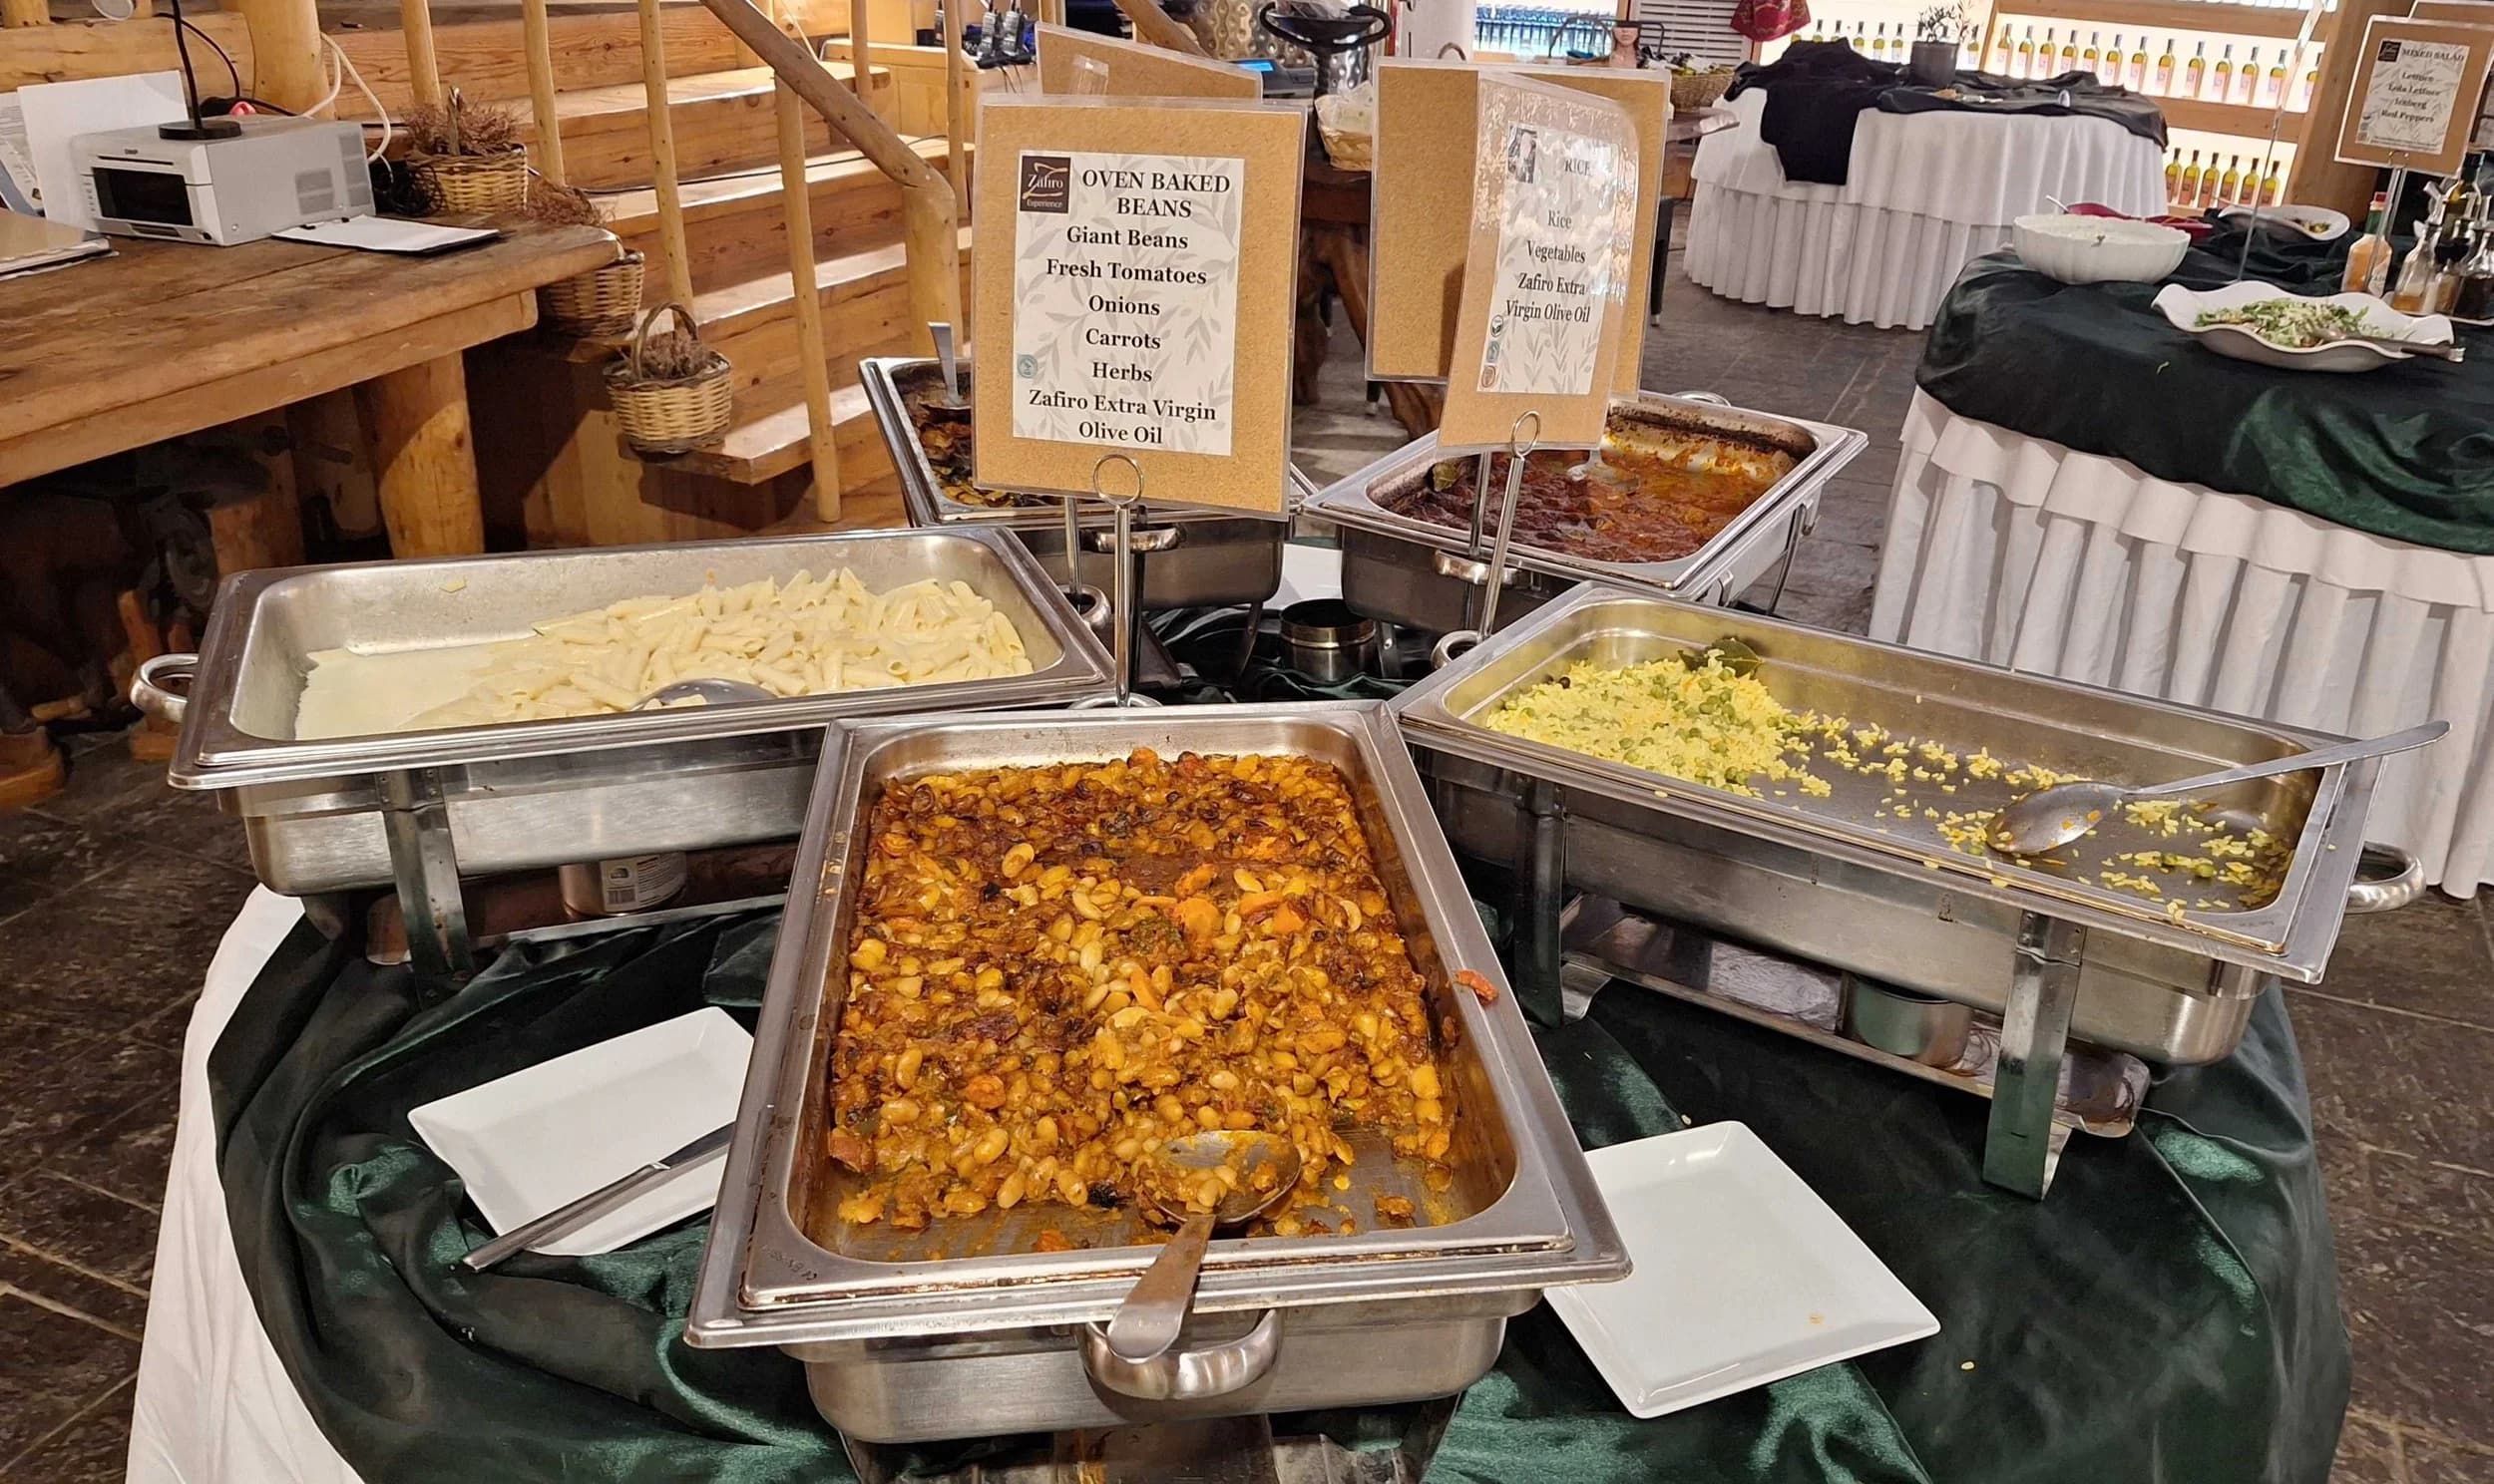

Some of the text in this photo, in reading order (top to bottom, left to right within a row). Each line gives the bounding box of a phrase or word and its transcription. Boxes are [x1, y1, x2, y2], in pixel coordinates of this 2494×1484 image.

[2402, 48, 2433, 58] MIXED
[2434, 51, 2465, 62] SALAD
[2394, 98, 2428, 110] Iceberg
[2399, 113, 2434, 123] Peppers
[1028, 174, 1063, 188] Zafiro
[1082, 170, 1230, 193] OVEN BAKED
[1027, 198, 1063, 208] Experience
[1116, 197, 1192, 218] BEANS
[1547, 209, 1572, 229] Rice
[1066, 226, 1189, 249] Giant Beans
[1526, 240, 1586, 264] Vegetables
[1046, 258, 1207, 284] Fresh Tomatoes
[1517, 272, 1586, 296] Zafiro Extra
[1088, 294, 1160, 316] Onions
[1505, 299, 1591, 323] Virgin Olive Oil
[1085, 328, 1161, 350] Carrots
[1092, 362, 1152, 382] Herbs
[1029, 389, 1217, 422] Zafiro Extra Virgin
[1078, 421, 1162, 444] Olive Oil
